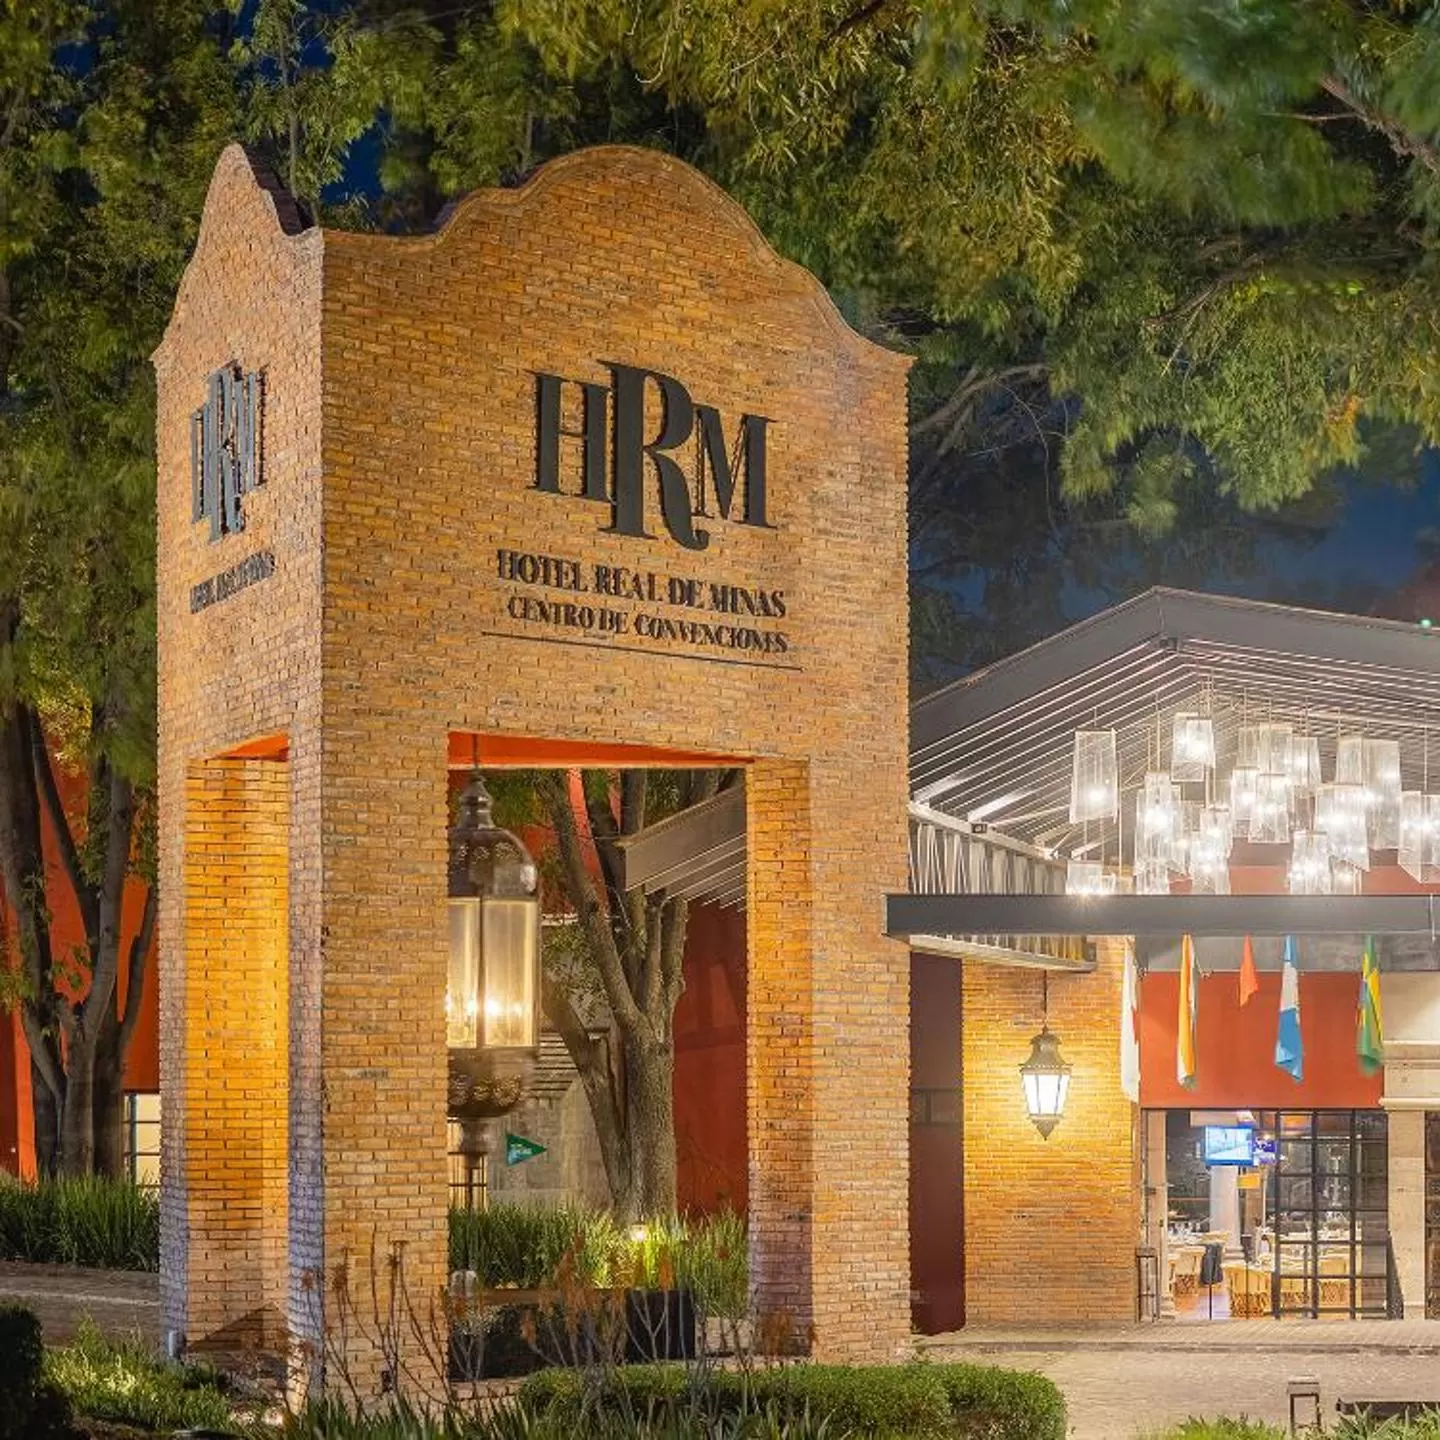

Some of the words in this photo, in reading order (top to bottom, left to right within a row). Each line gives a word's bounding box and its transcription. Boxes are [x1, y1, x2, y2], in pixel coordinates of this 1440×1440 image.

[525, 359, 778, 551] HRM
[497, 549, 588, 592] HOTEL
[594, 564, 663, 602] REAL
[668, 577, 703, 609] DE
[709, 583, 787, 618] MINAS
[507, 596, 594, 630] CENTRO
[598, 608, 629, 634] DE
[634, 613, 789, 653] CONVENCIONES
